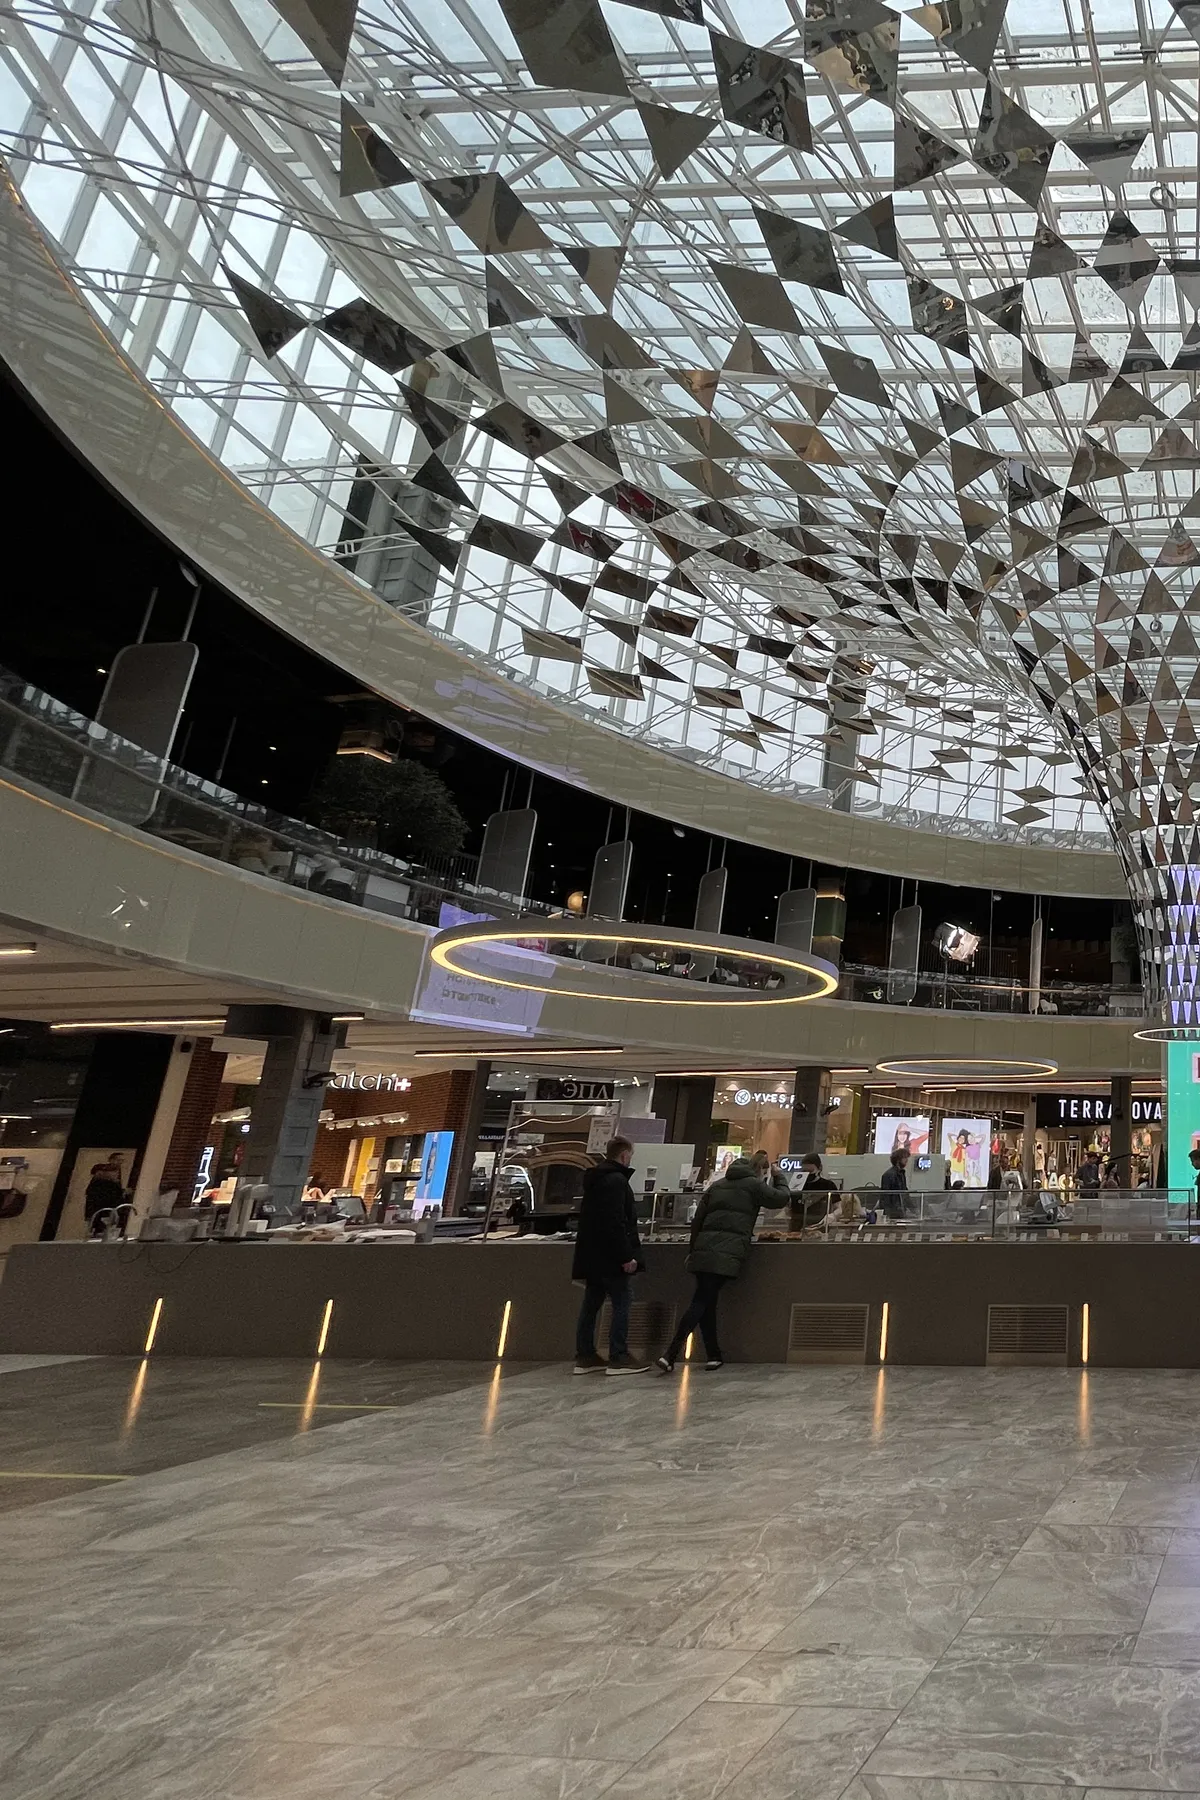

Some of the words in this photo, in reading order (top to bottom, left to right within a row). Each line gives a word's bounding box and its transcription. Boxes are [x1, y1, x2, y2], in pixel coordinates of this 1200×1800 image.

[753, 1092, 786, 1103] YVES
[1059, 1099, 1162, 1120] TERROVA
[780, 1157, 802, 1171] буш
